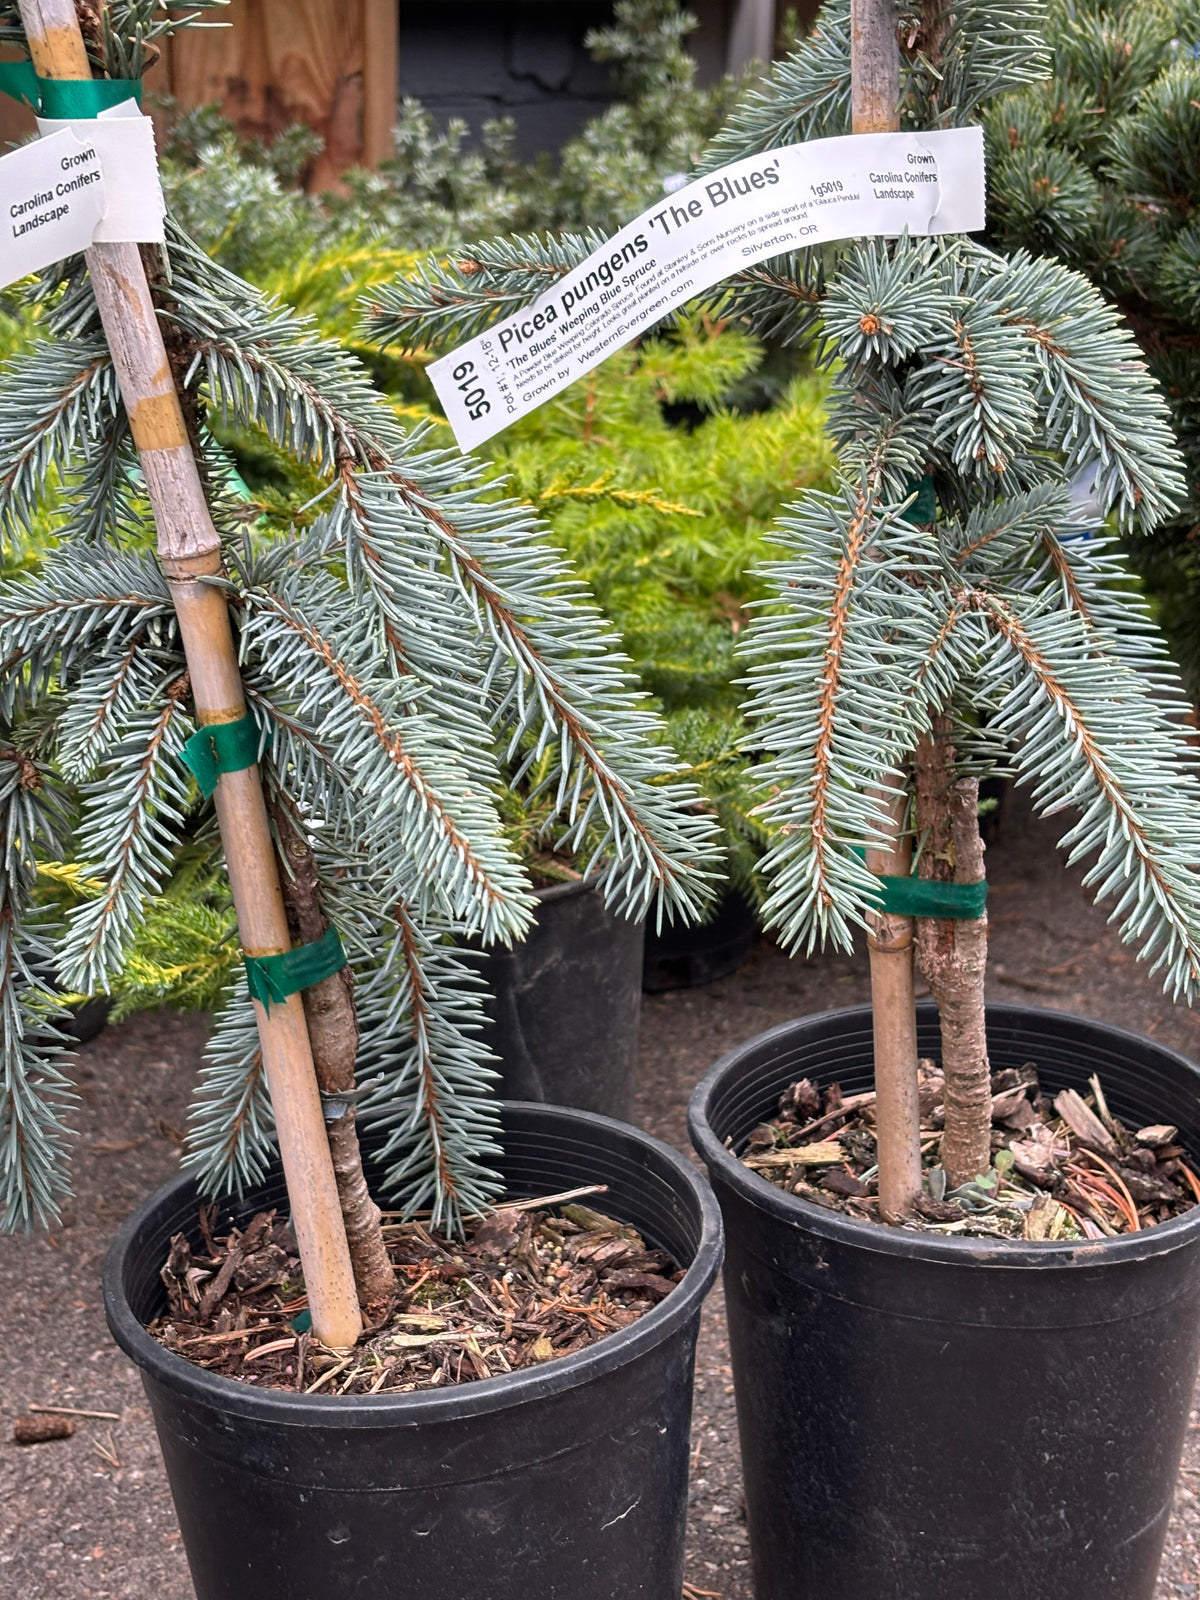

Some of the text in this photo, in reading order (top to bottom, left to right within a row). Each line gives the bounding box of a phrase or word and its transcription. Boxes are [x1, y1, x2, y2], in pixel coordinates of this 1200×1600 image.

[61, 149, 95, 170] Grown
[869, 172, 938, 183] Carolina Conifers
[907, 153, 936, 164] Grown
[10, 170, 100, 218] Carolina Conifers
[810, 180, 844, 197] 1g5019
[874, 188, 914, 201] Landscape
[12, 204, 70, 238] Landscape
[498, 159, 780, 354] Picea pungens 'The Blues'
[557, 329, 585, 350] Weeping
[585, 308, 612, 331] Colorado
[635, 274, 656, 292] Found
[696, 238, 716, 252] Sons
[716, 223, 746, 241] Nursery
[747, 219, 758, 227] on
[781, 204, 799, 215] sport
[602, 312, 621, 329] Looks
[621, 299, 637, 315] great
[661, 276, 670, 286] on
[710, 243, 725, 255] over
[726, 233, 748, 247] rocks
[757, 218, 783, 233] spread
[506, 259, 657, 369] 'The Blues' Weeping Blue Spruce
[522, 224, 819, 402] Grown by WesternEvergreen.com Silverton, OR
[452, 360, 491, 421] 5019
[503, 392, 518, 414] Pot
